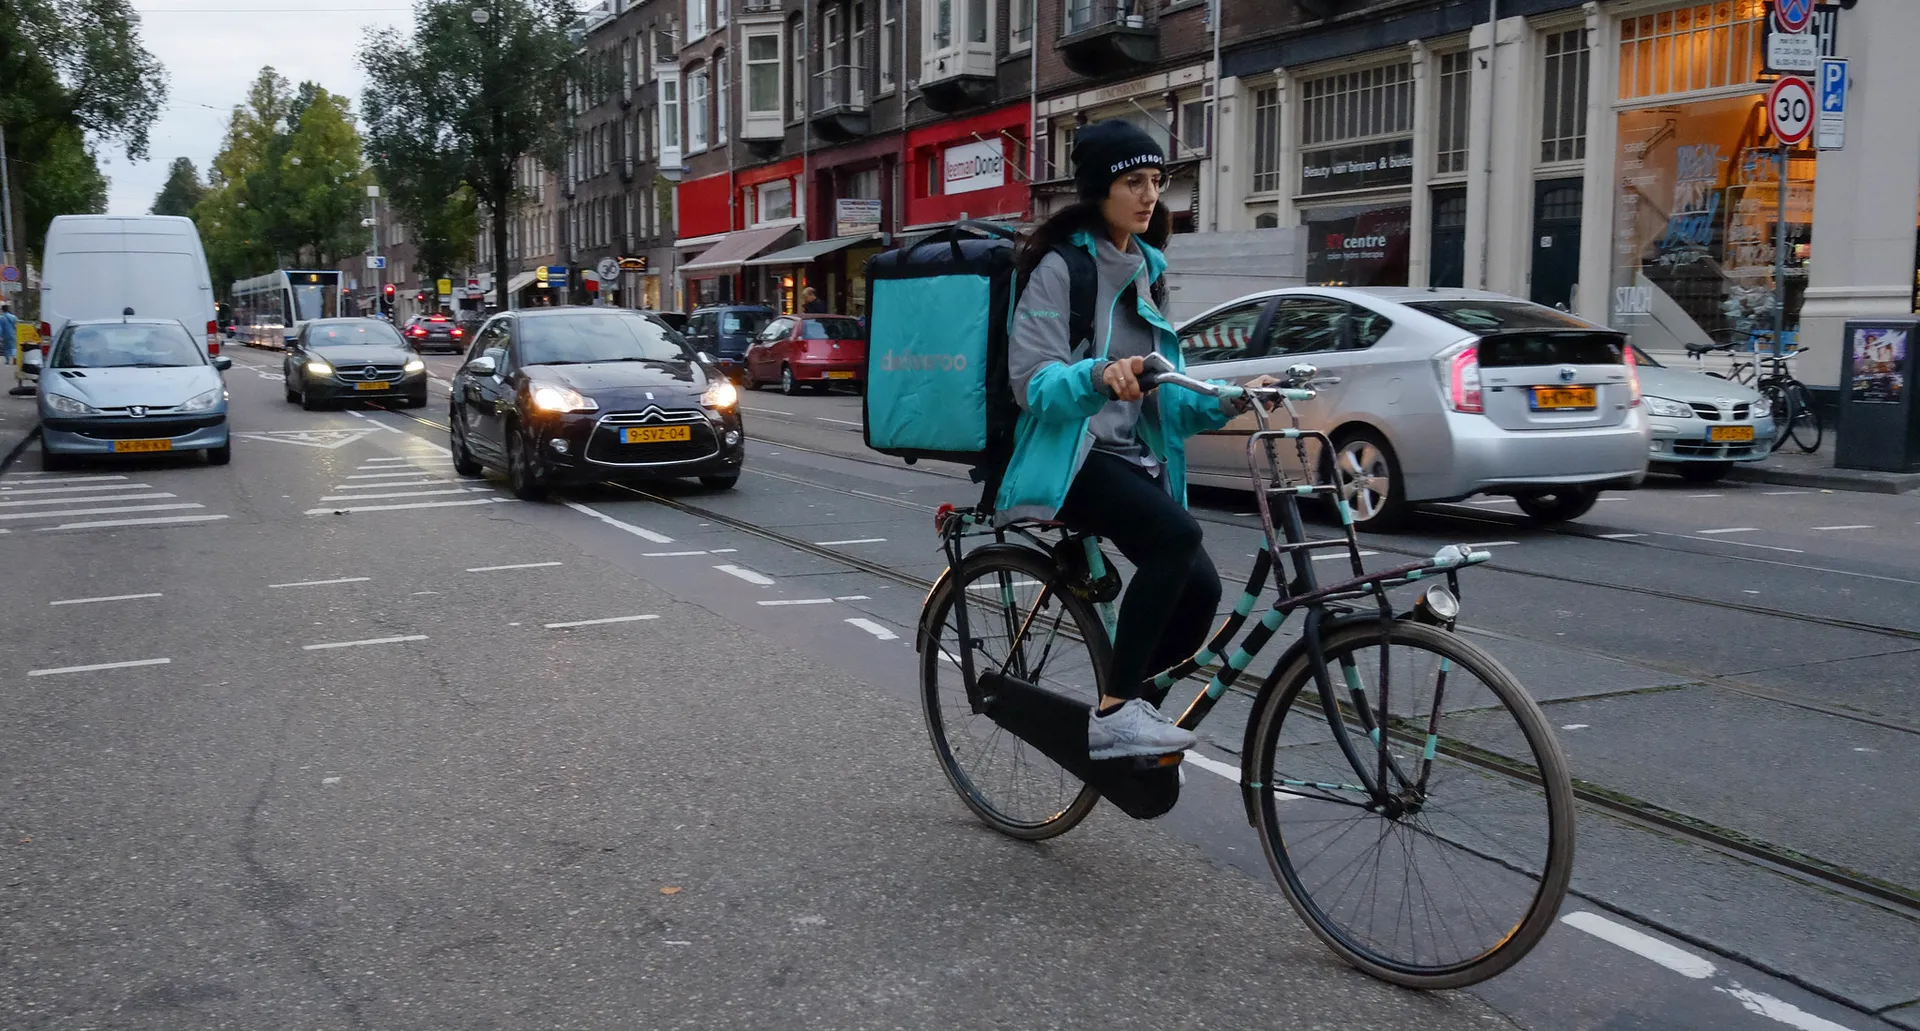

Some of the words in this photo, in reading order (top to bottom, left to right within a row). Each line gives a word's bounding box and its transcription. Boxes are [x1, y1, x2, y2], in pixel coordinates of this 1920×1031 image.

[1826, 64, 1842, 92] P
[1778, 97, 1806, 122] 30
[1379, 157, 1387, 169] &
[1614, 286, 1653, 312] STACH
[630, 427, 685, 441] 9-SVZ-04
